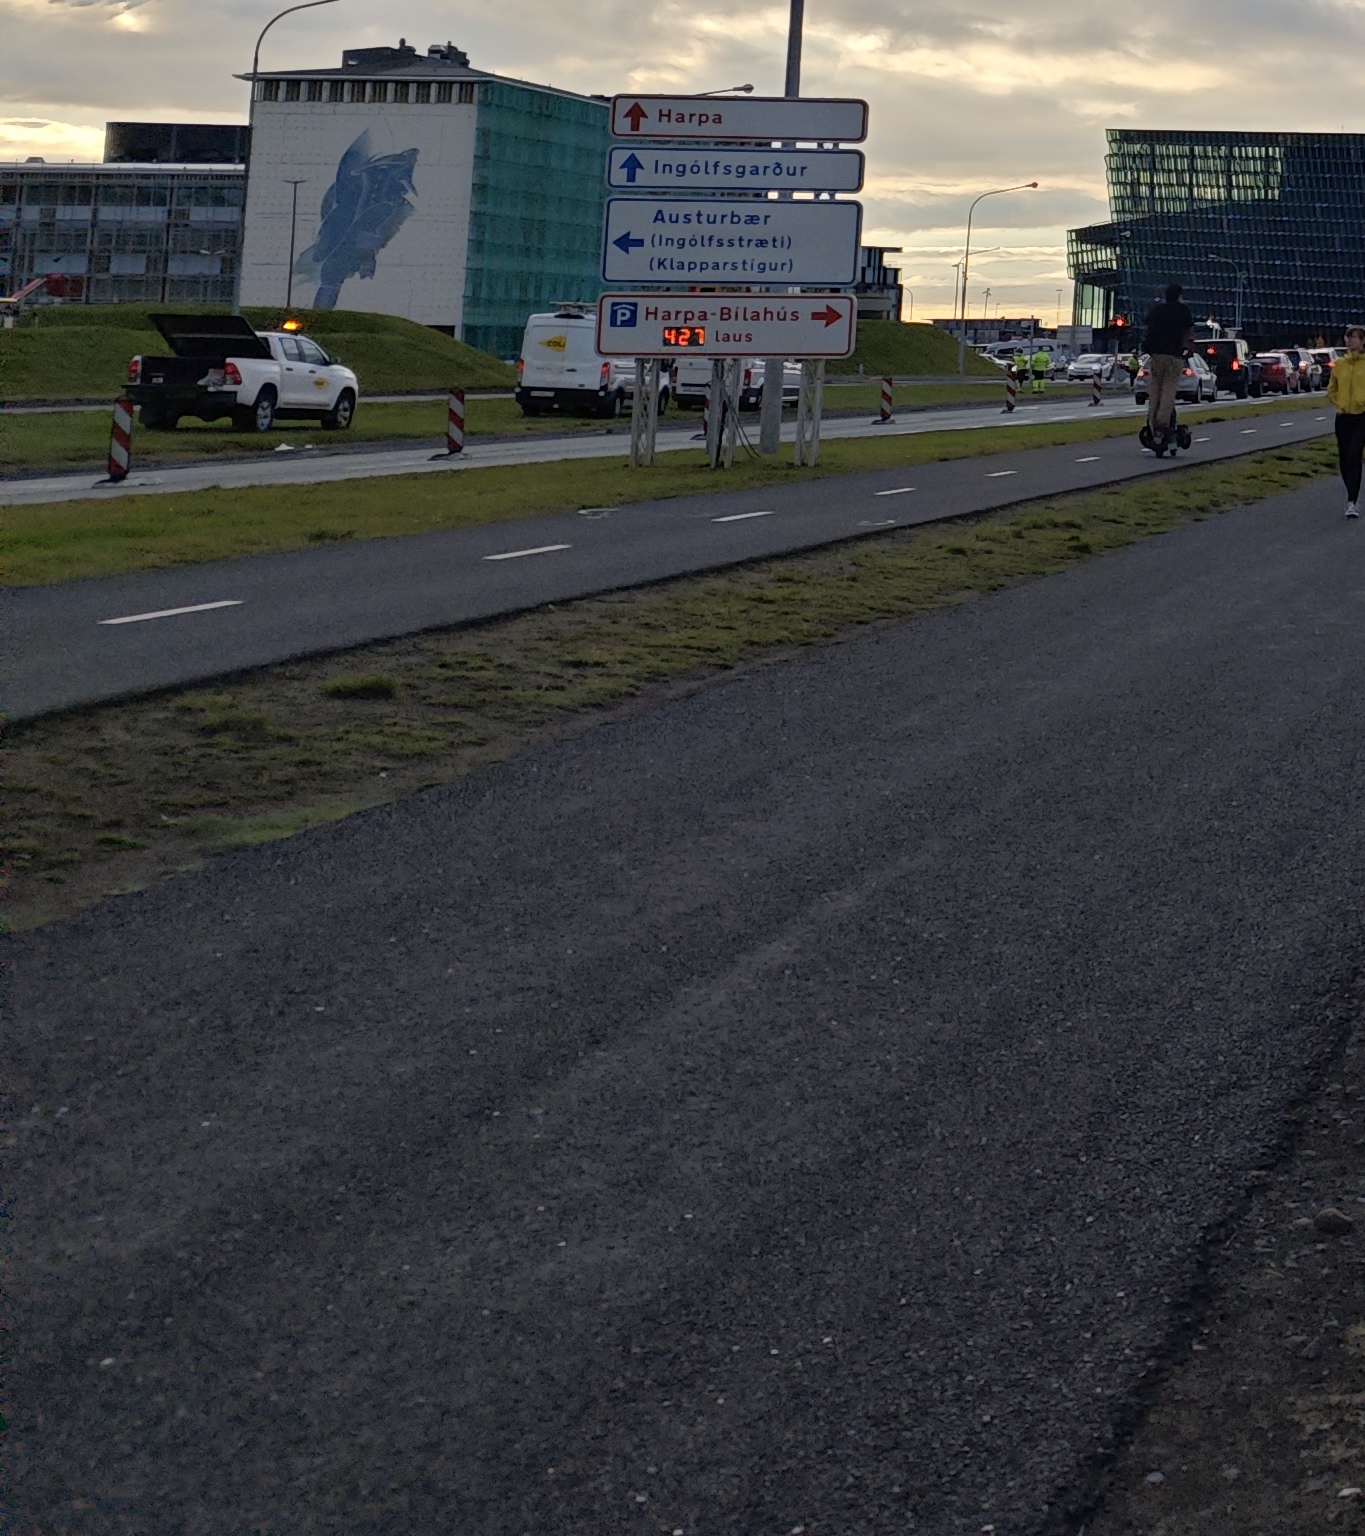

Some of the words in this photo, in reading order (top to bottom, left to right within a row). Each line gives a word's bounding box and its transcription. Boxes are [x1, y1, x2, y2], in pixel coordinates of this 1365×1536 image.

[658, 108, 722, 126] Harpa
[654, 159, 808, 178] Ingólfsgarður
[652, 209, 771, 225] Austurbær
[651, 233, 792, 250] (Ingólfsstræti)
[649, 257, 793, 274] (Klapparstígur)
[644, 306, 800, 324] Harpa-Bílahús
[664, 328, 705, 347] 427
[715, 330, 753, 343] laus
